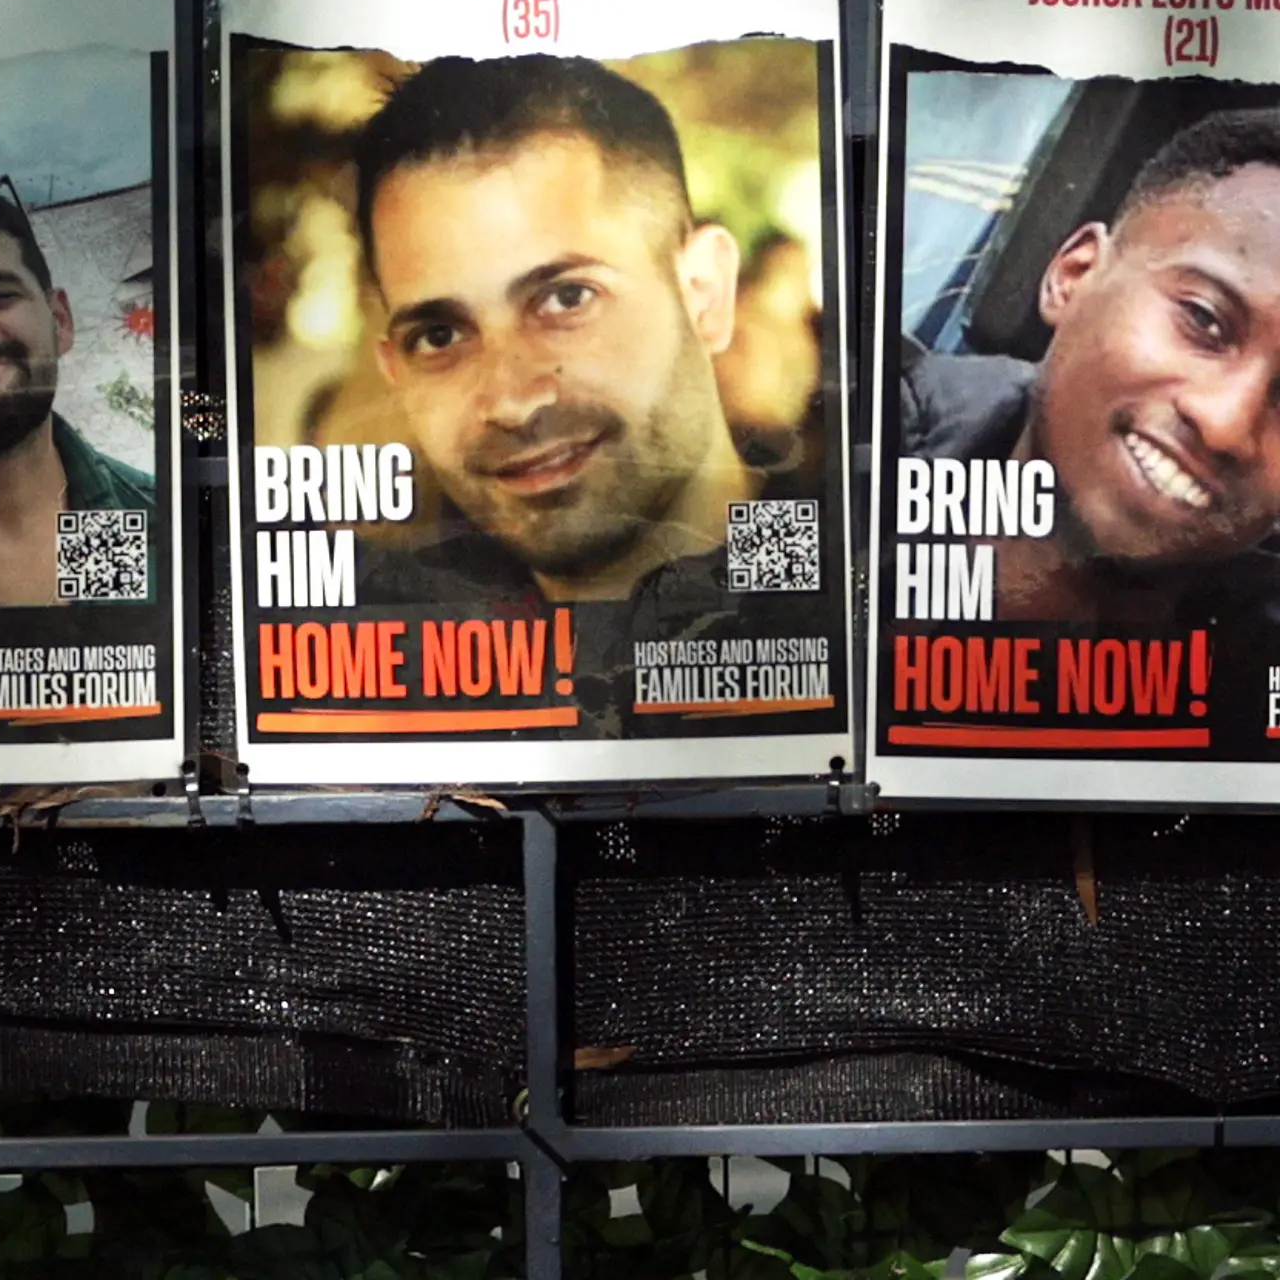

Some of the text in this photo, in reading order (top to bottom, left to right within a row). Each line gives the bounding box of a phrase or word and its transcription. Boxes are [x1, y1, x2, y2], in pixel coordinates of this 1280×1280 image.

[1164, 18, 1218, 66] (21)
[895, 457, 1055, 538] BRING
[895, 543, 993, 621] HIM
[46, 646, 80, 671] AND
[83, 645, 155, 670] MISSING
[635, 637, 828, 666] HOSTAGES AND MISSING
[72, 671, 156, 708] FORUM
[635, 664, 829, 703] FAMILIES FORUM
[893, 629, 1212, 718] HOME NOW!
